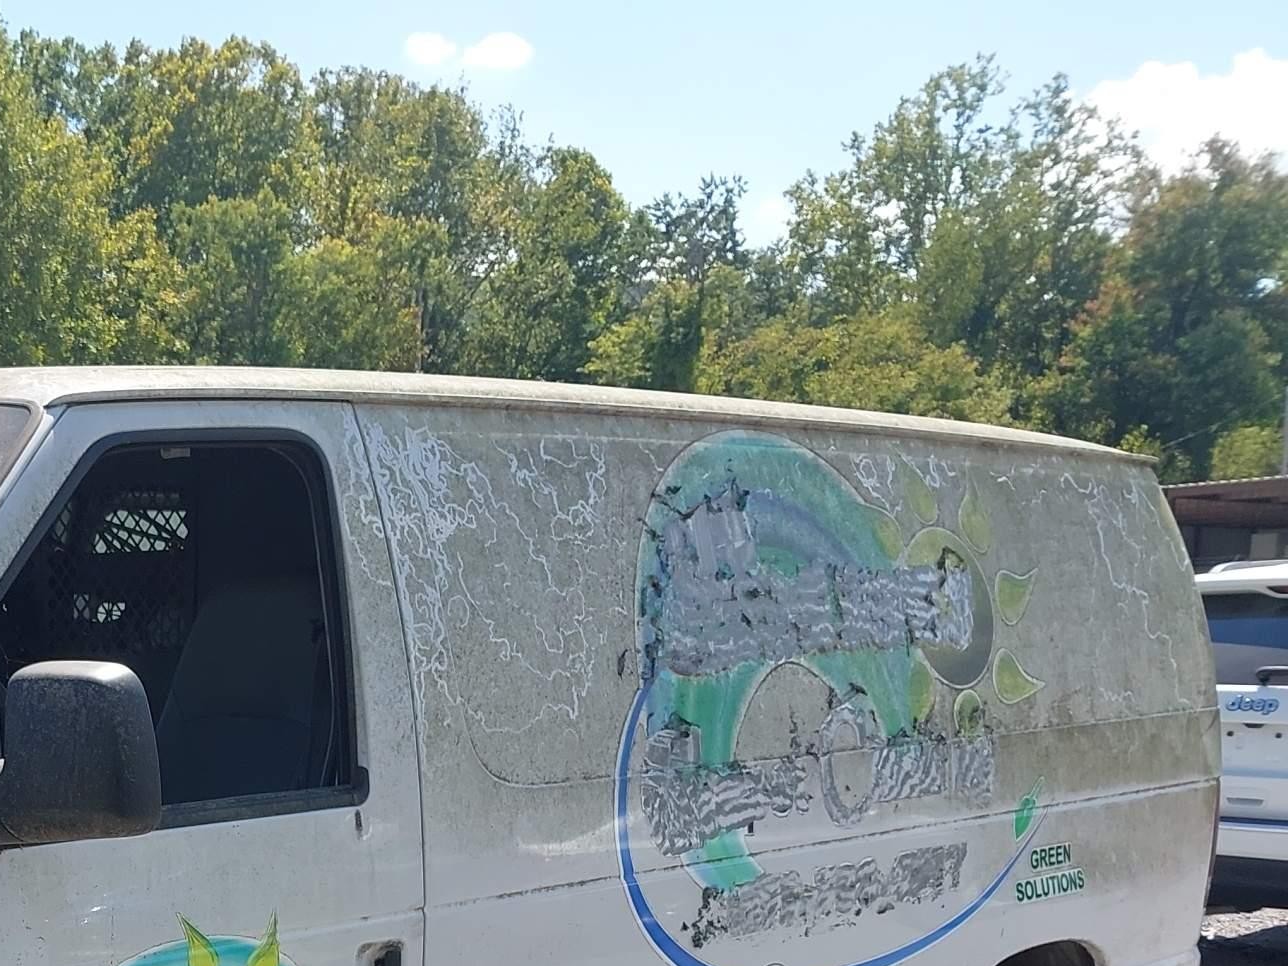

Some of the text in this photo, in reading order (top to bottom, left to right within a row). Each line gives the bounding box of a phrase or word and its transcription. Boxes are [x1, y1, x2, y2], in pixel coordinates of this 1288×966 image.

[1225, 694, 1280, 716] Jeep
[1030, 843, 1072, 870] GREEN
[1015, 869, 1085, 902] SOLUTIONS
